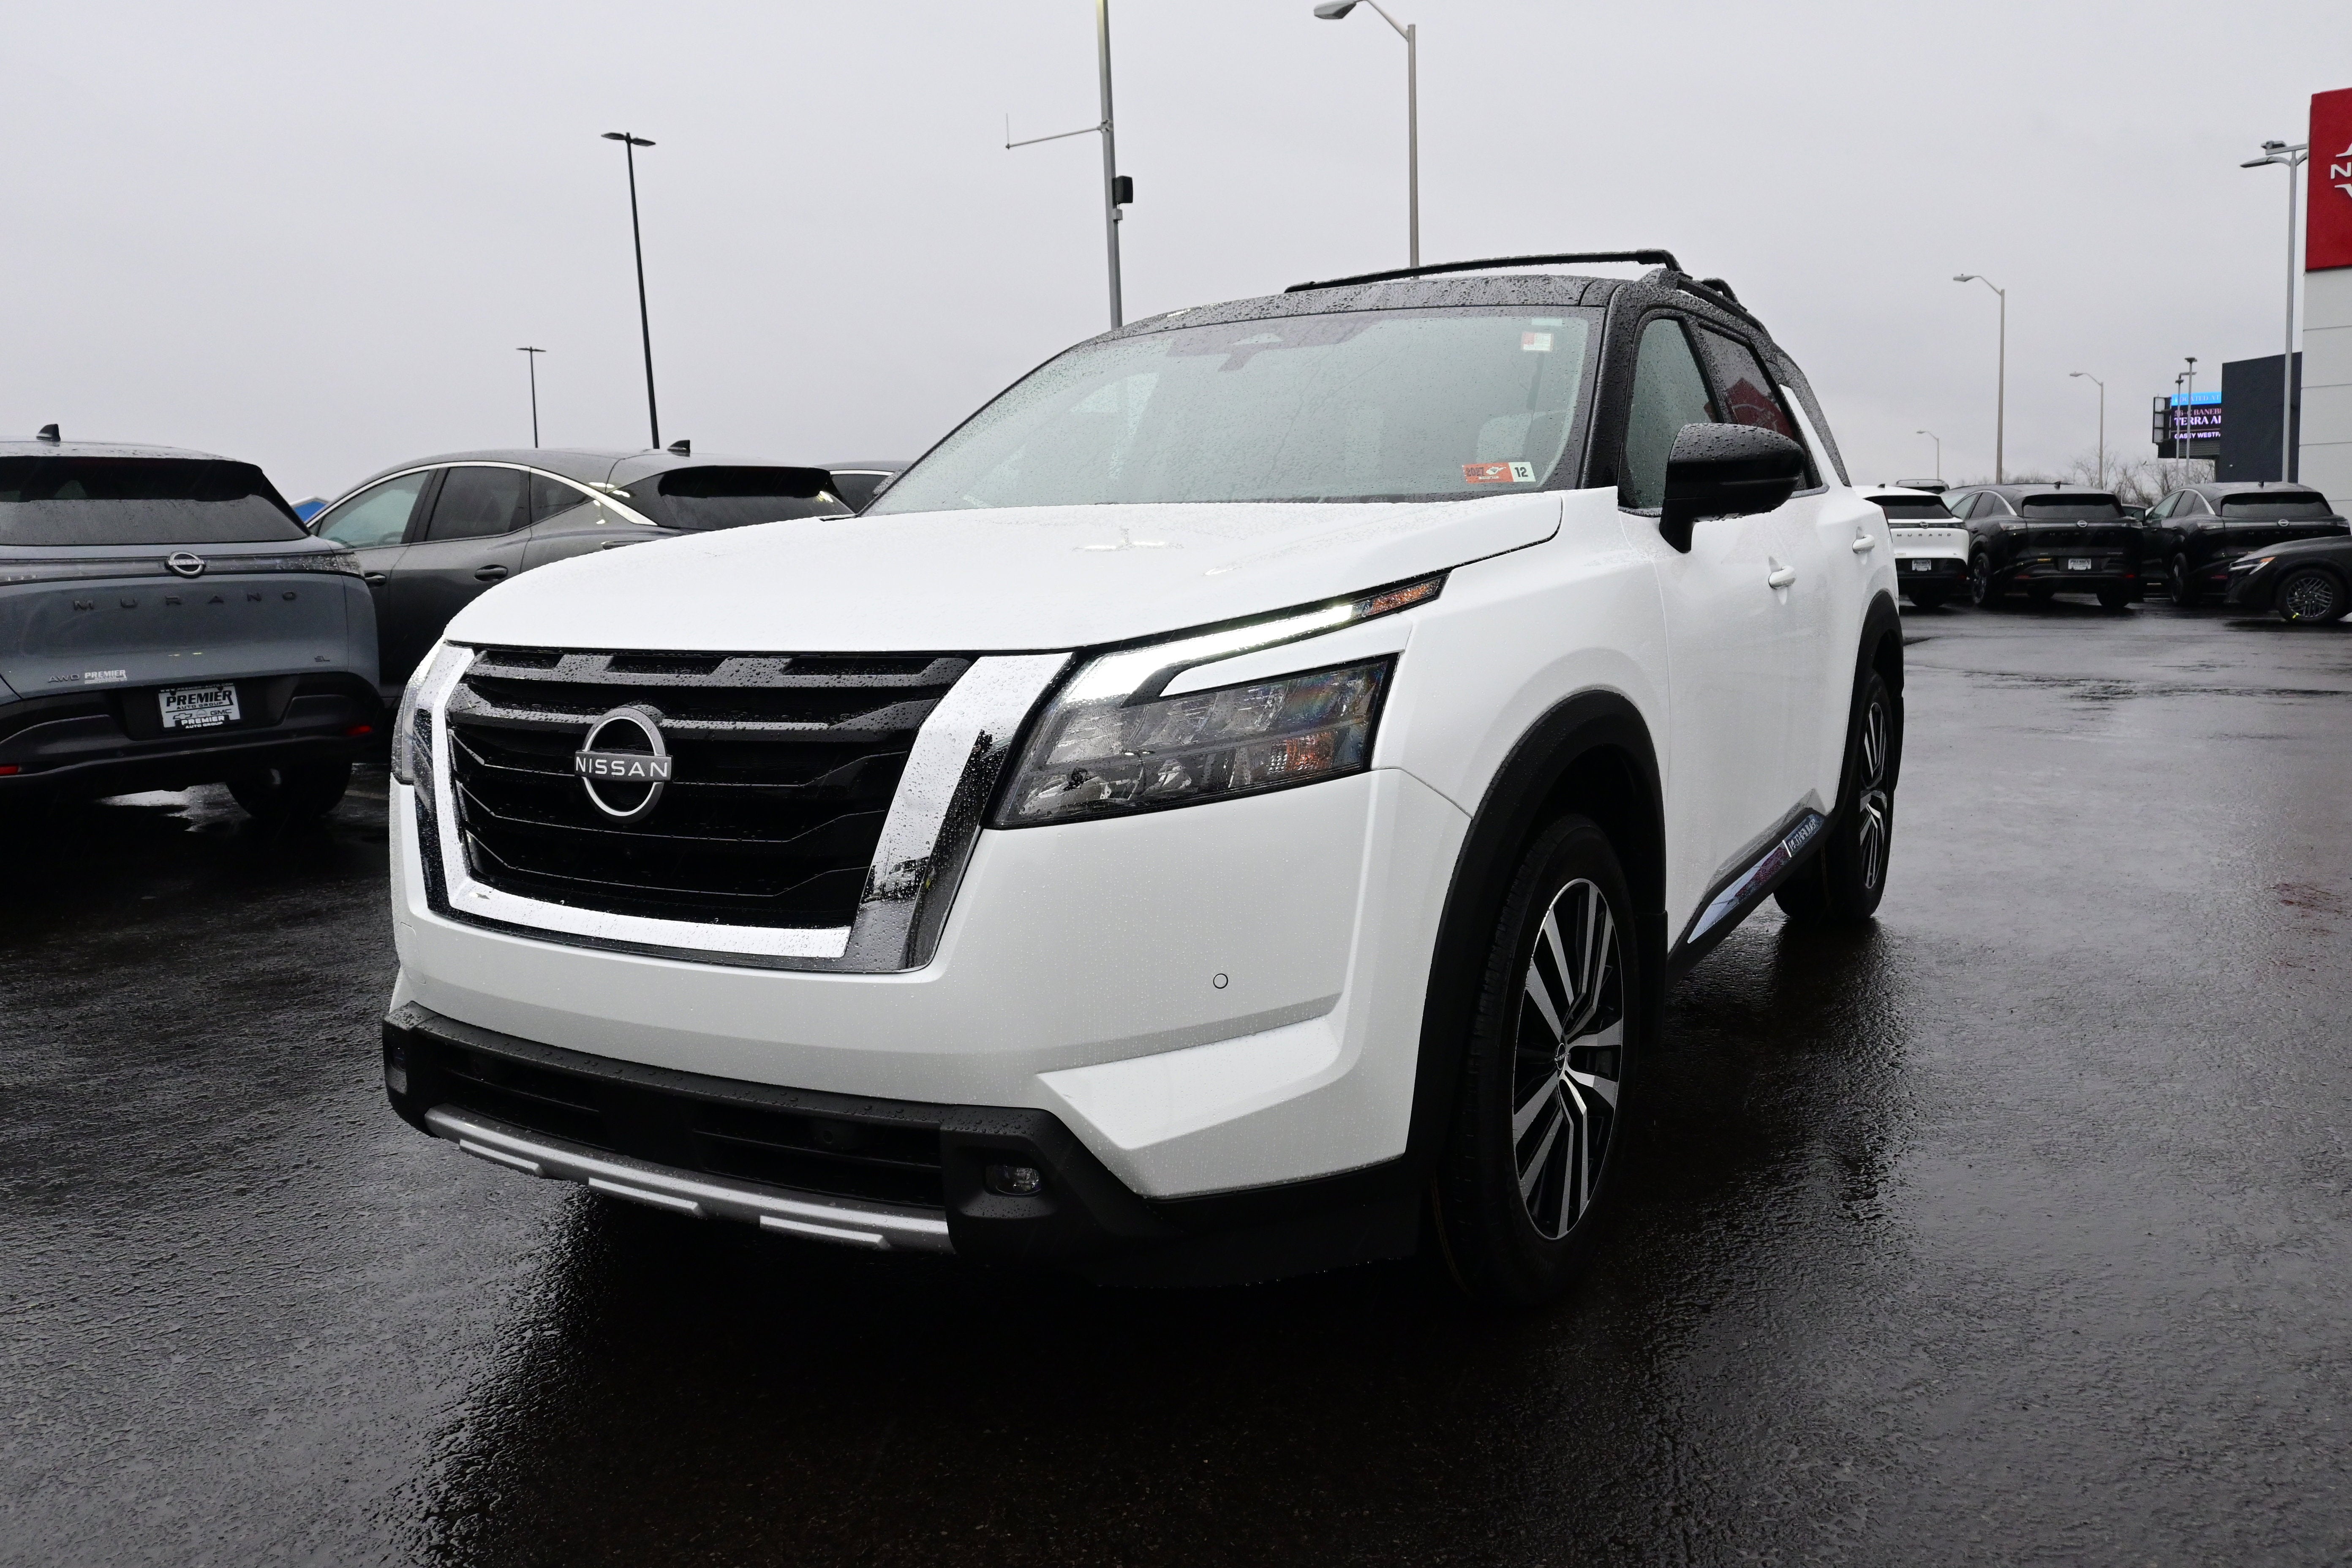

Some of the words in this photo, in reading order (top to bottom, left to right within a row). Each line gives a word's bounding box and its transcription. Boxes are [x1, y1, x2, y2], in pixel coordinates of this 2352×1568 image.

[2174, 416, 2209, 426] TERRA
[1466, 467, 1485, 477] 2027
[1514, 467, 1529, 477] 12
[74, 591, 297, 611] MURANO
[48, 674, 80, 683] AWD
[84, 670, 127, 679] PREMIER
[166, 690, 234, 707] PREMIER
[181, 715, 225, 726] PREMIER
[576, 756, 667, 777] NISSAN
